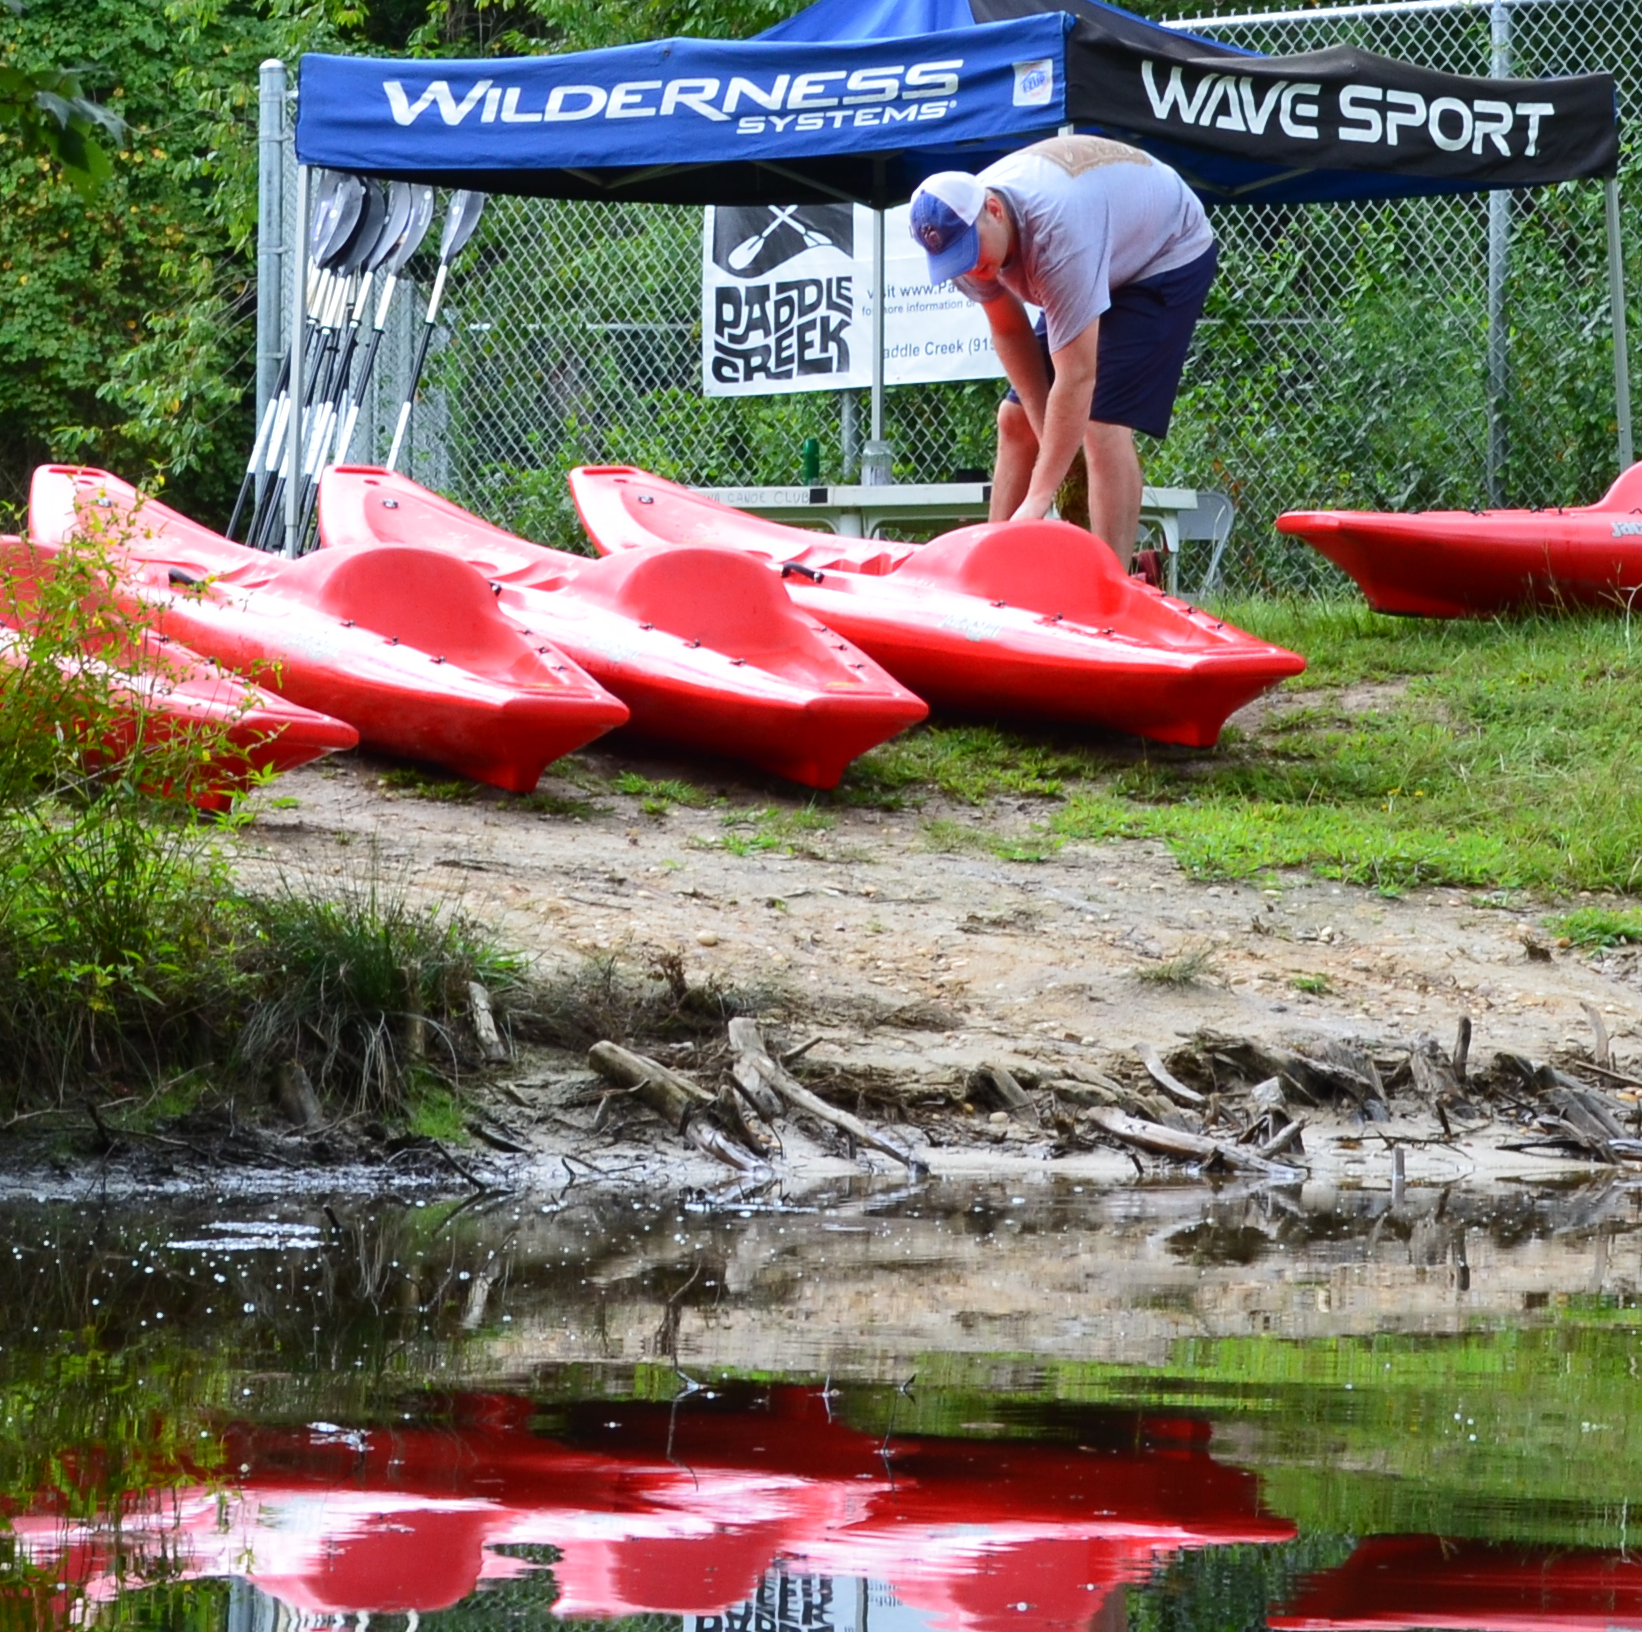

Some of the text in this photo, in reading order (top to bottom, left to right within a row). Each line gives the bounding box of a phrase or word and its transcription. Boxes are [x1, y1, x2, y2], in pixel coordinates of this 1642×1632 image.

[383, 59, 964, 126] WILDERNESS
[1141, 60, 1555, 157] WAVE SPORT
[713, 275, 854, 344] PADDLE
[867, 278, 957, 299] vit www.Pa
[906, 299, 963, 313] information
[711, 315, 852, 384] CREEK
[884, 343, 920, 359] addle
[925, 339, 964, 356] Creek
[727, 492, 766, 504] CANOE
[773, 490, 809, 504] CLUB
